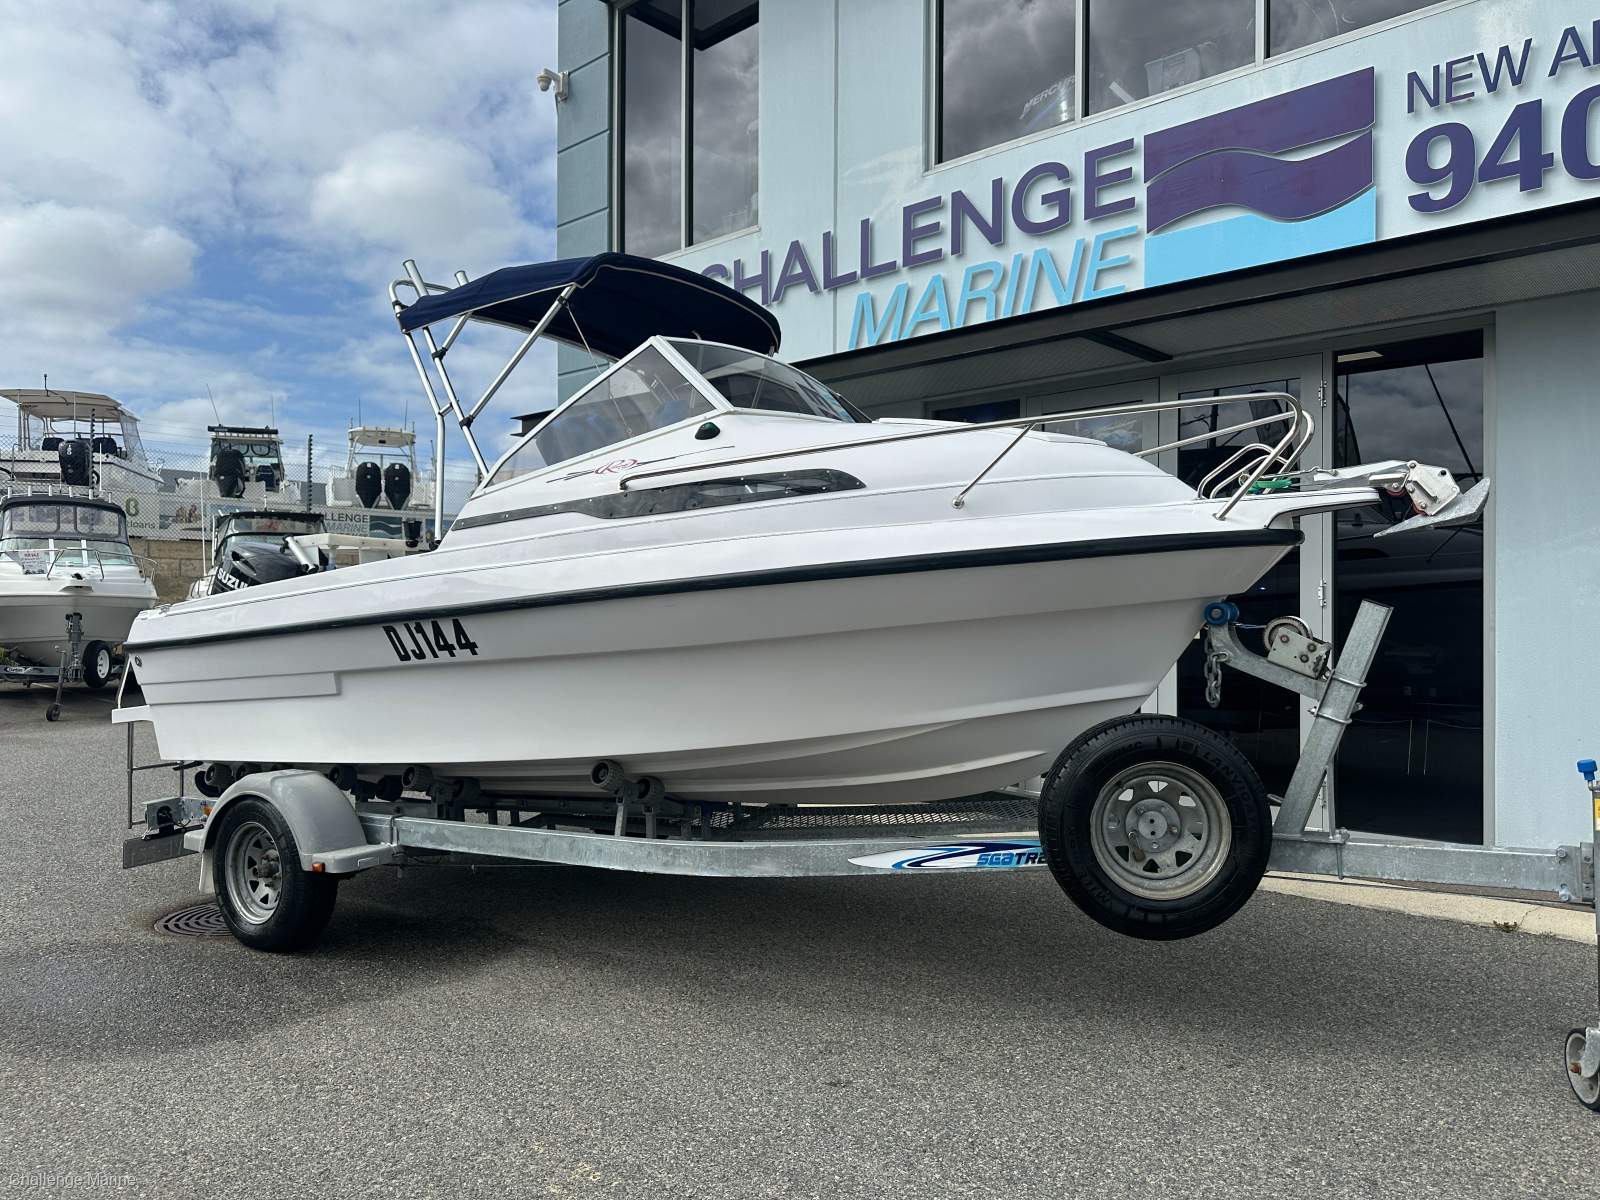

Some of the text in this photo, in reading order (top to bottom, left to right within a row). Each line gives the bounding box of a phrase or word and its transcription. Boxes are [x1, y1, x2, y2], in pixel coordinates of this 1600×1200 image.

[1407, 17, 1600, 113] NEW A
[847, 225, 1139, 350] MARINE
[382, 618, 479, 662] DJ144
